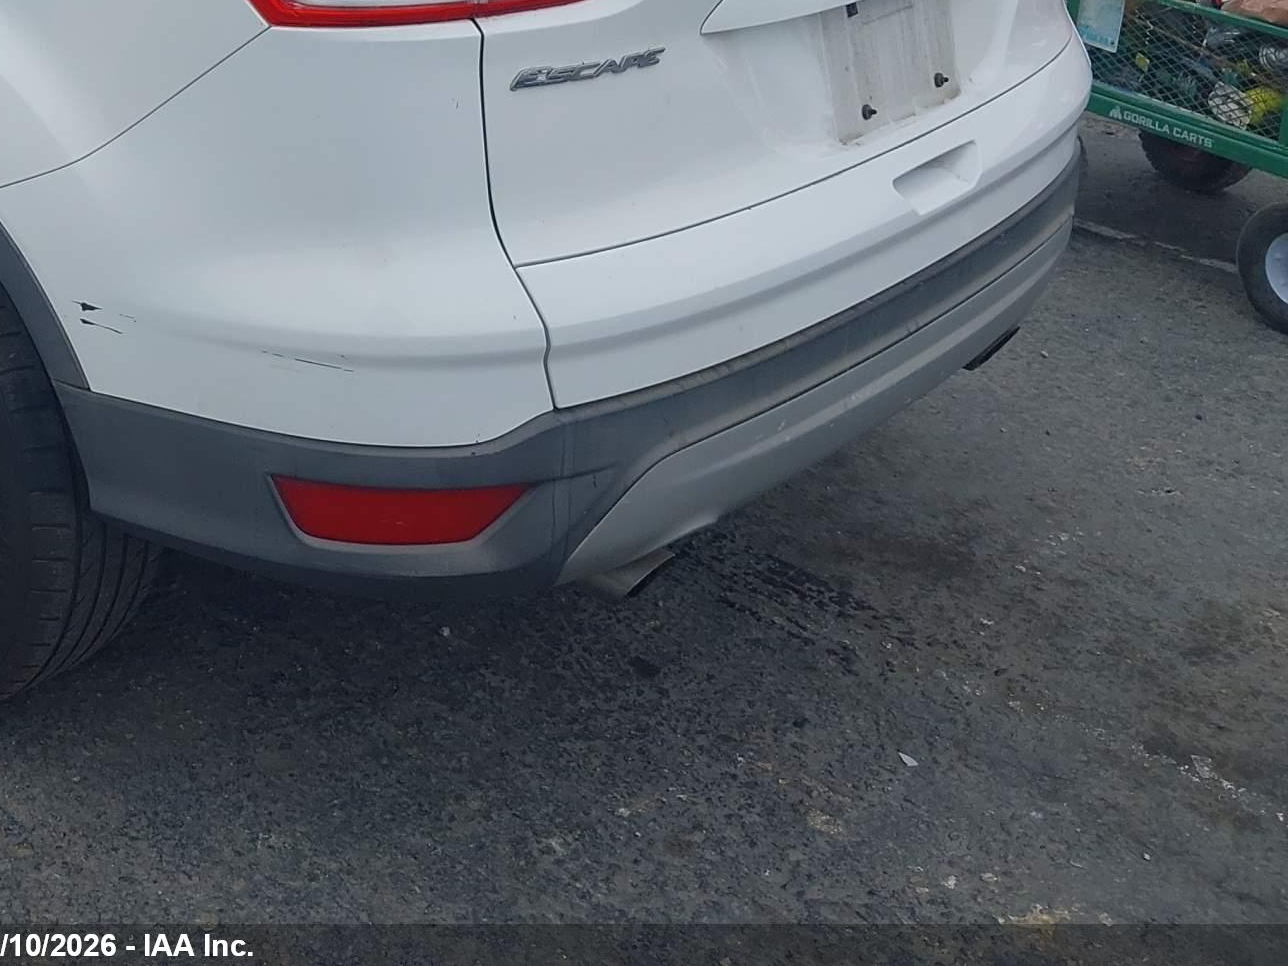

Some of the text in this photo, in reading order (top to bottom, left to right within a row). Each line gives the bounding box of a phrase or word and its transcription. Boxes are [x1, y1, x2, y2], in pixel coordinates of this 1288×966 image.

[510, 47, 666, 91] ESCAPE
[1123, 111, 1213, 147] GORILLA CARTS
